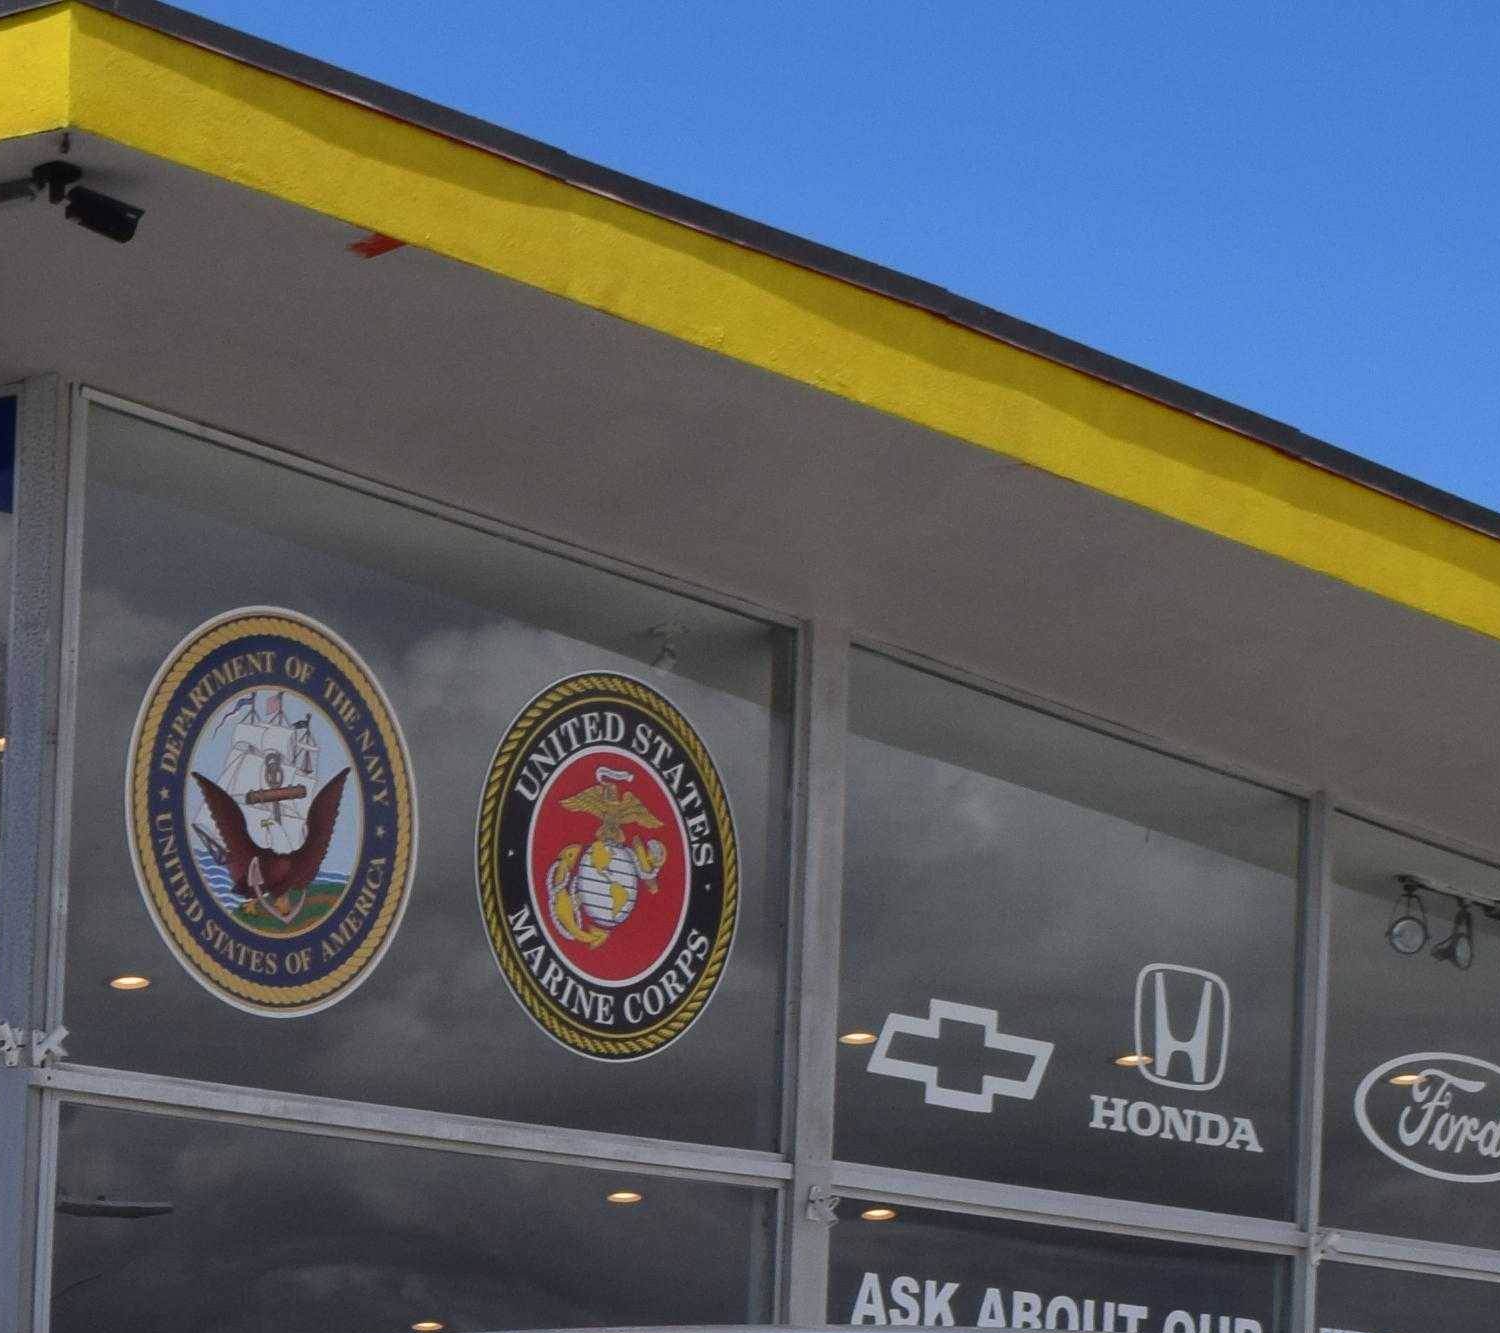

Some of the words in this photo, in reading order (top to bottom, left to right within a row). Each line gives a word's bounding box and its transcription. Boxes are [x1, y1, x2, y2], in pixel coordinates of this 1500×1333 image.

[160, 650, 276, 775] DEPARTMENT
[283, 655, 316, 683] OF
[324, 677, 361, 730] THE
[356, 729, 390, 806] NAVY
[514, 711, 625, 802] UNITED
[631, 722, 714, 868] STATES
[154, 812, 205, 923] UNITED
[202, 918, 278, 975] STATES
[283, 949, 313, 975] OF
[320, 857, 387, 963] AMERICA
[507, 903, 615, 1026] MARINE
[623, 928, 711, 1026] CORPS
[1089, 1094, 1264, 1153] HONDA
[850, 1271, 960, 1327] ASK
